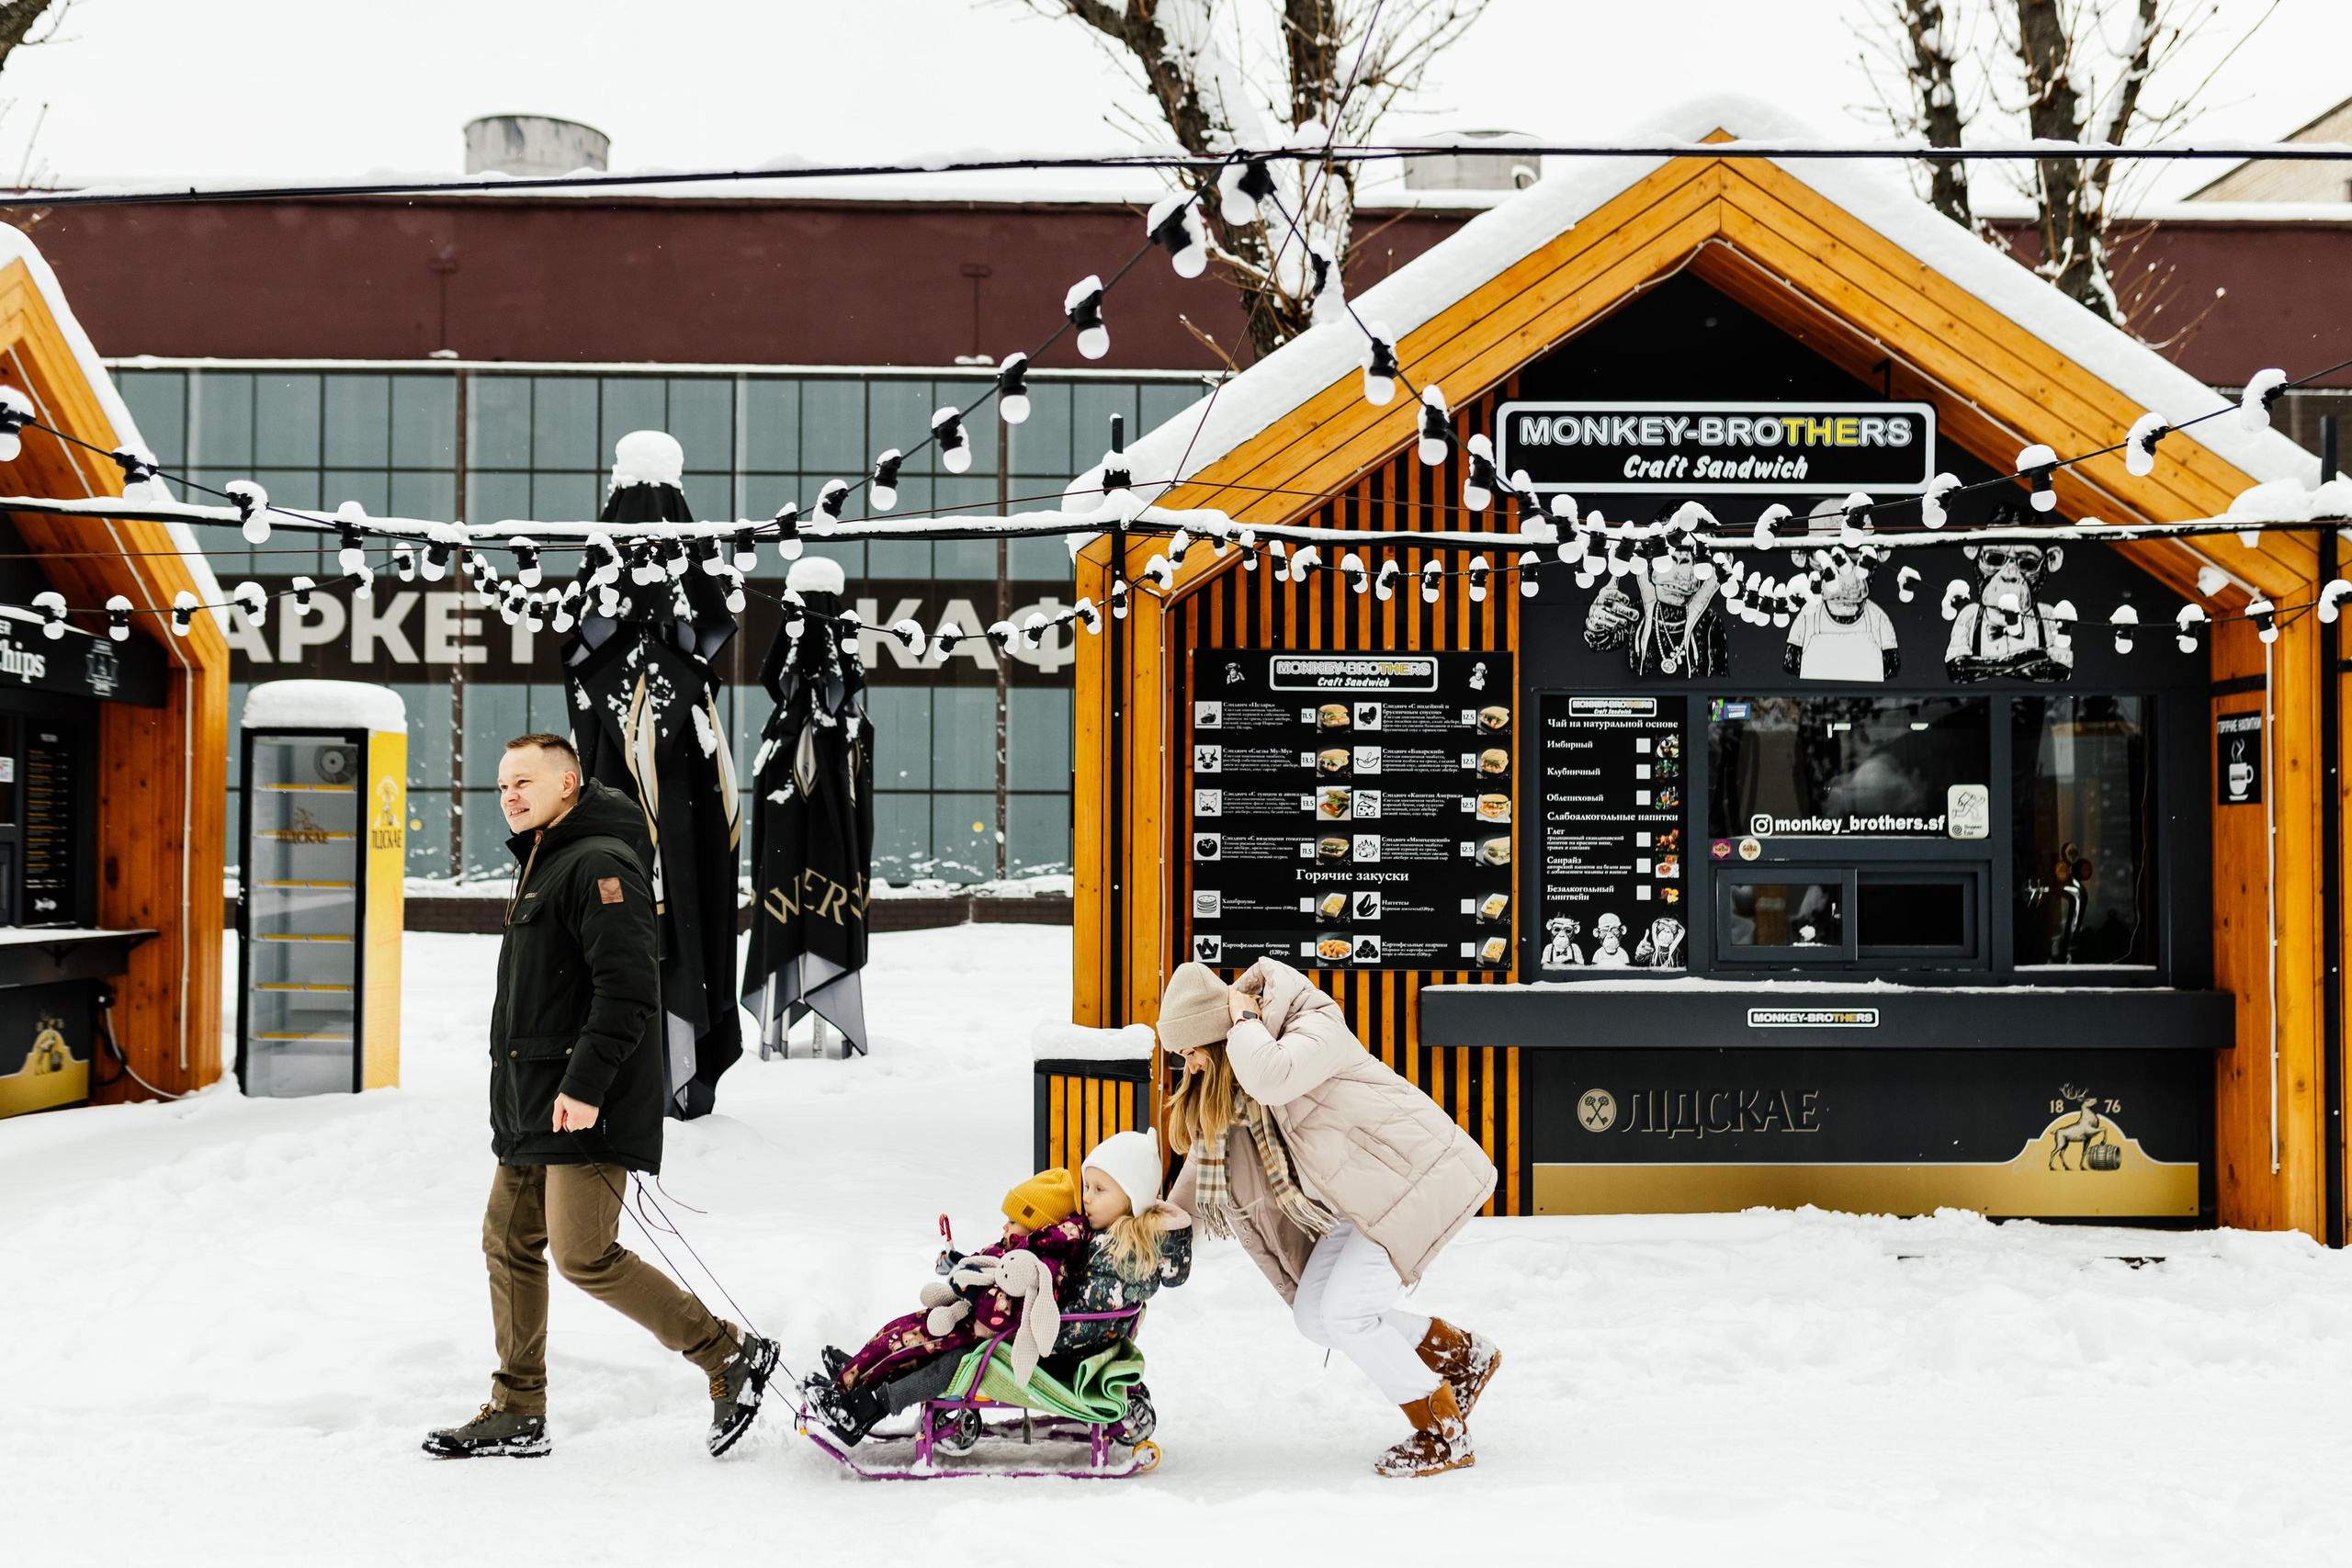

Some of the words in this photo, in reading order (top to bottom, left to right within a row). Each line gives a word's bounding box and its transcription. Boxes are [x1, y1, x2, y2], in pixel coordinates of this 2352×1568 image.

[1520, 415, 1913, 447] MONKEY-BROTHERS
[1623, 454, 1687, 479] Craft
[1693, 455, 1808, 479] Sandwich
[0, 638, 46, 683] hips
[1276, 660, 1431, 676] MONKEY-BROTHERS
[1317, 677, 1343, 688] Craft
[1344, 677, 1390, 688] Sandwich
[1548, 719, 1566, 728] Чай
[1584, 719, 1643, 730] натуральной
[1548, 740, 1592, 750] Имбирный
[1547, 768, 1600, 777] Клубничный
[1547, 812, 1635, 820] Слабоалкогольные
[1775, 814, 1945, 834] monkey_brothers.sf
[1296, 869, 1352, 884] Горячие
[1357, 873, 1408, 884] закуски
[1753, 1013, 1873, 1023] MONKEY-BROTHERS
[1621, 1089, 1820, 1139] ЛІДСКАЕ
[2050, 1100, 2064, 1114] 18
[2104, 1100, 2121, 1114] 76
